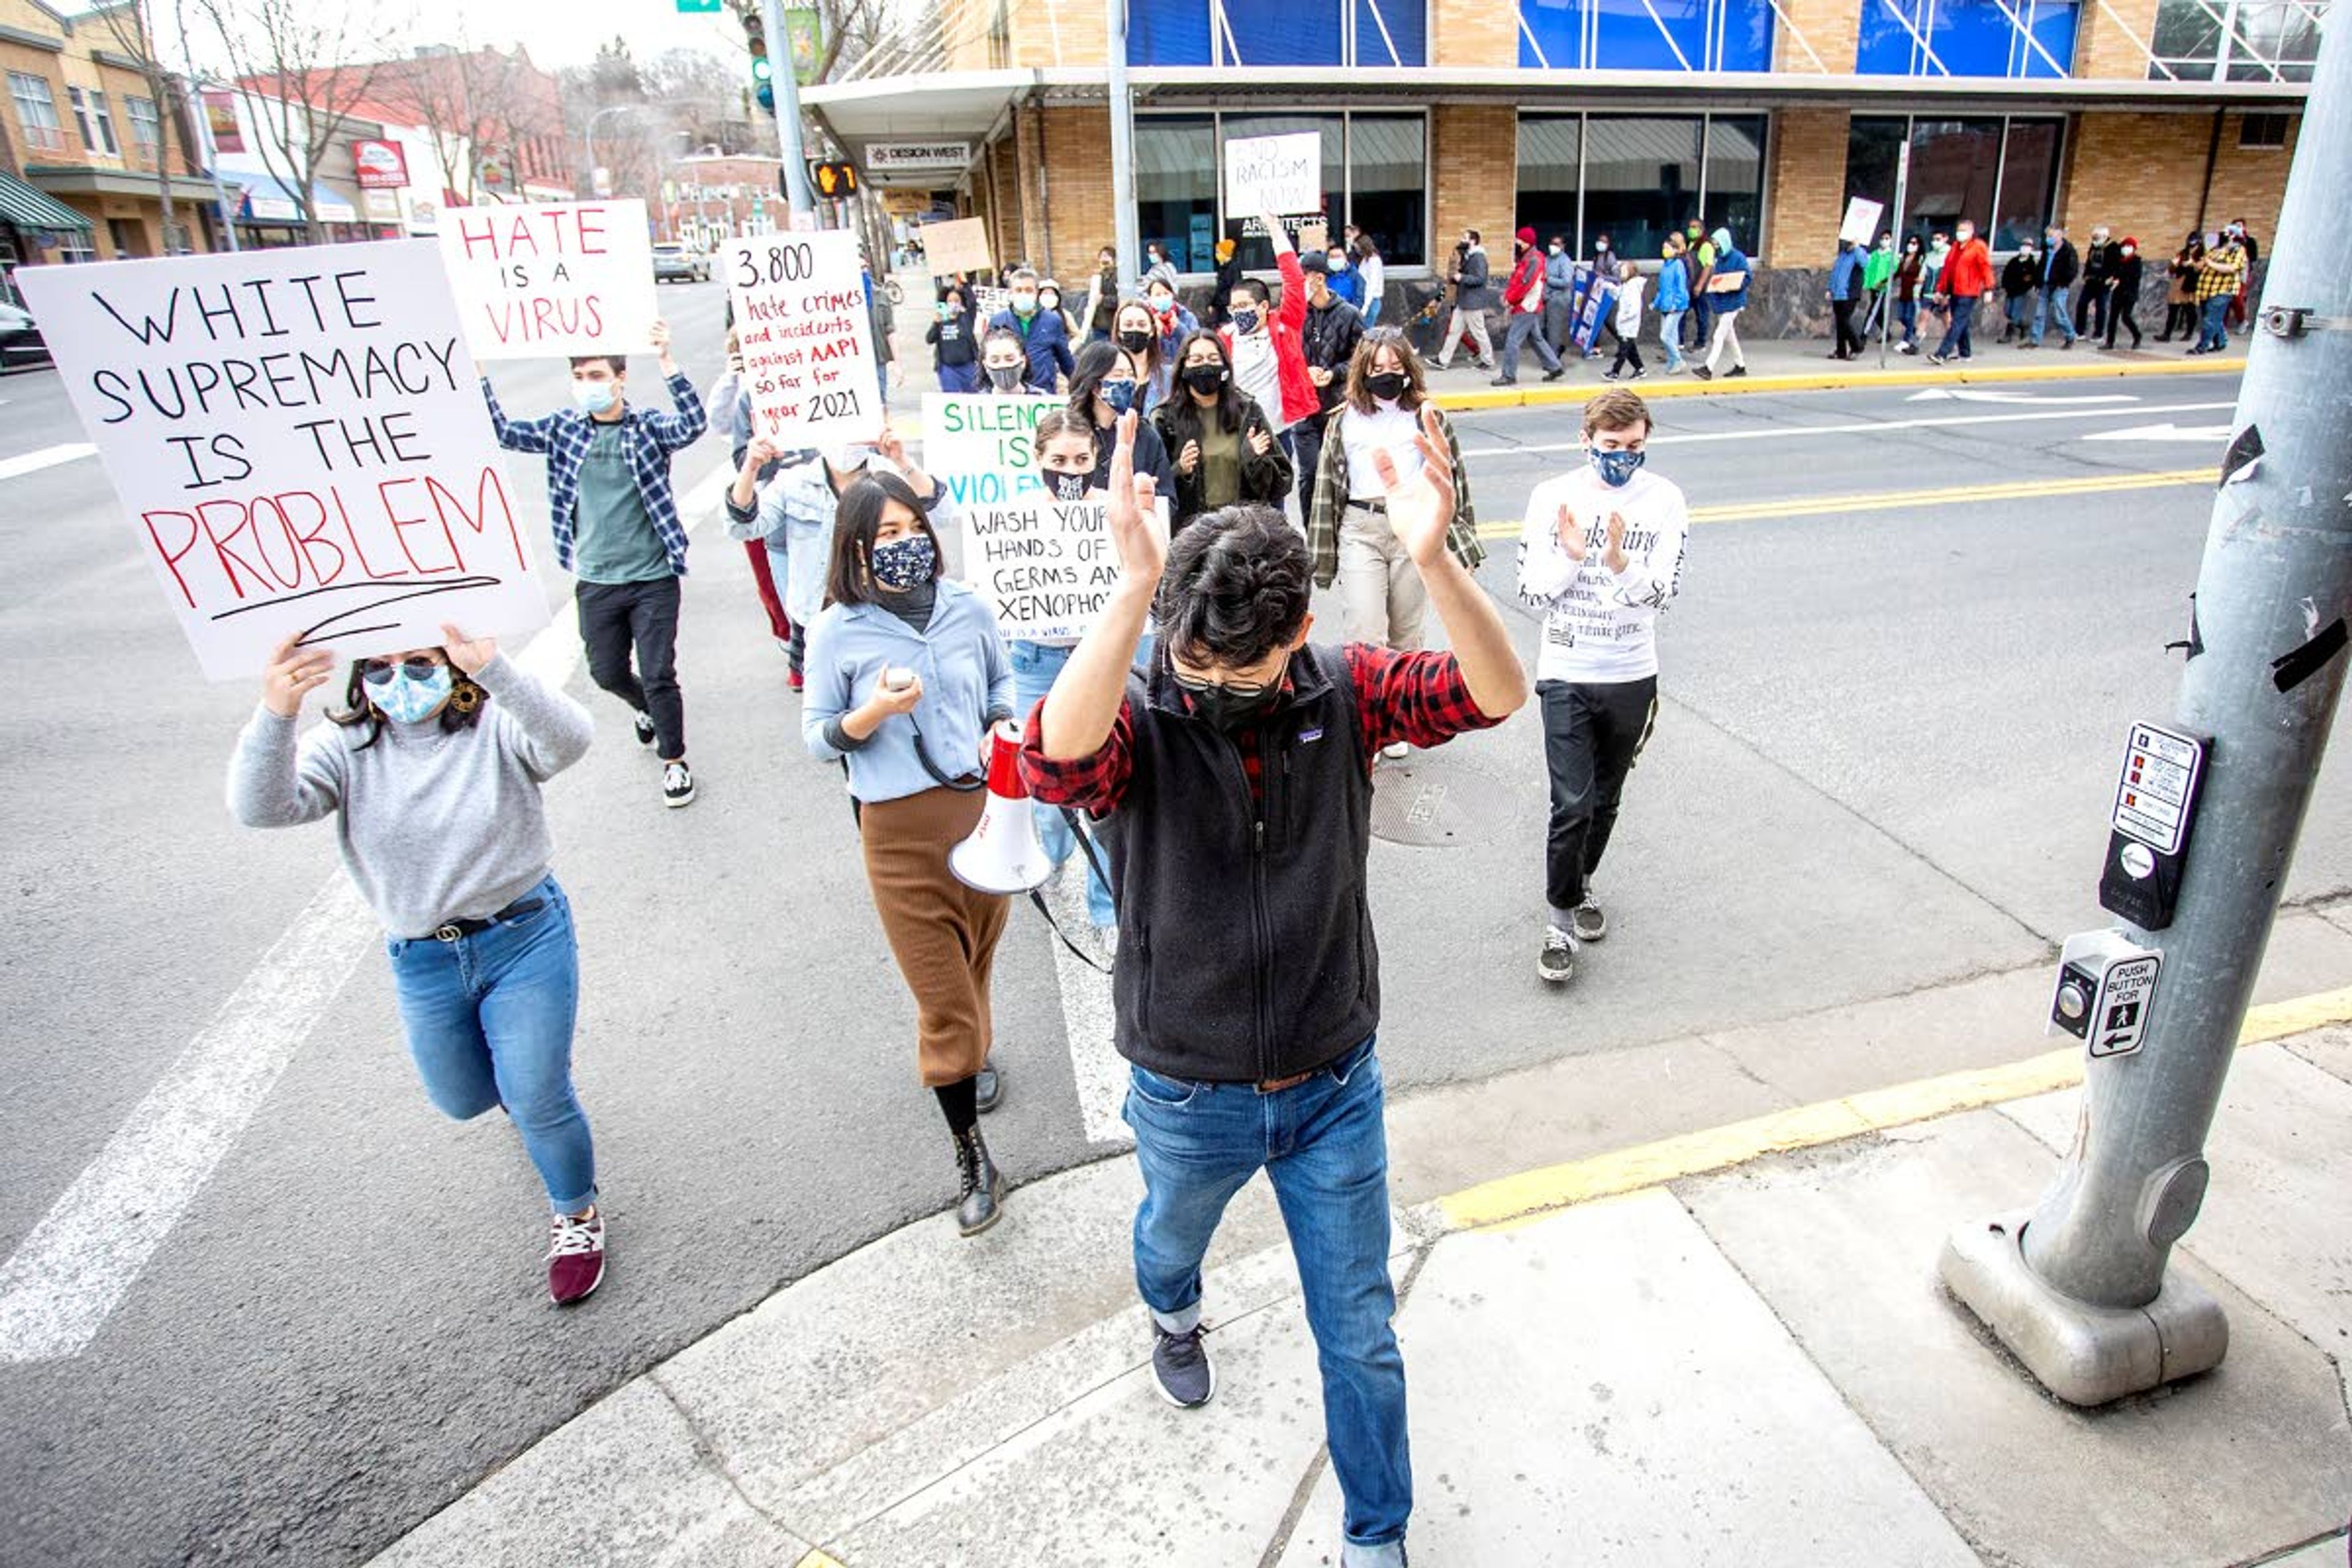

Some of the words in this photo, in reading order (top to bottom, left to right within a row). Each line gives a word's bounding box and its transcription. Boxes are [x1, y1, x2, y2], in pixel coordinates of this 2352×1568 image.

[889, 148, 929, 157] DESIGN
[932, 147, 964, 157] WEST
[1237, 158, 1308, 184] RACISM
[459, 209, 607, 260] HATE
[501, 265, 529, 288] IS
[553, 263, 570, 282] A
[737, 243, 812, 288] 3,800
[92, 271, 382, 345] WHITE
[486, 295, 603, 344] VIRUS
[746, 295, 790, 321] hate
[802, 289, 862, 313] crimes
[745, 327, 772, 344] and
[778, 316, 853, 339] incidents
[749, 350, 803, 377] against
[811, 337, 861, 363] AAPI
[93, 337, 459, 423] SUPREMACY
[778, 374, 801, 390] far
[813, 368, 840, 387] for
[762, 403, 799, 435] year
[807, 388, 861, 423] 2021
[167, 434, 252, 489] IS
[294, 412, 431, 471] THE
[998, 436, 1030, 467] IS
[971, 510, 1038, 535] WASH
[141, 466, 526, 609] PROBLEM
[985, 538, 1063, 562] HANDS
[1077, 538, 1107, 562] OF
[993, 565, 1078, 594] GERMS
[1090, 565, 1120, 586] AN
[997, 592, 1110, 621] XENOPHO
[2107, 976, 2153, 992] BUTTON
[2117, 963, 2149, 979] PUSH
[2115, 990, 2139, 1003] FOR
